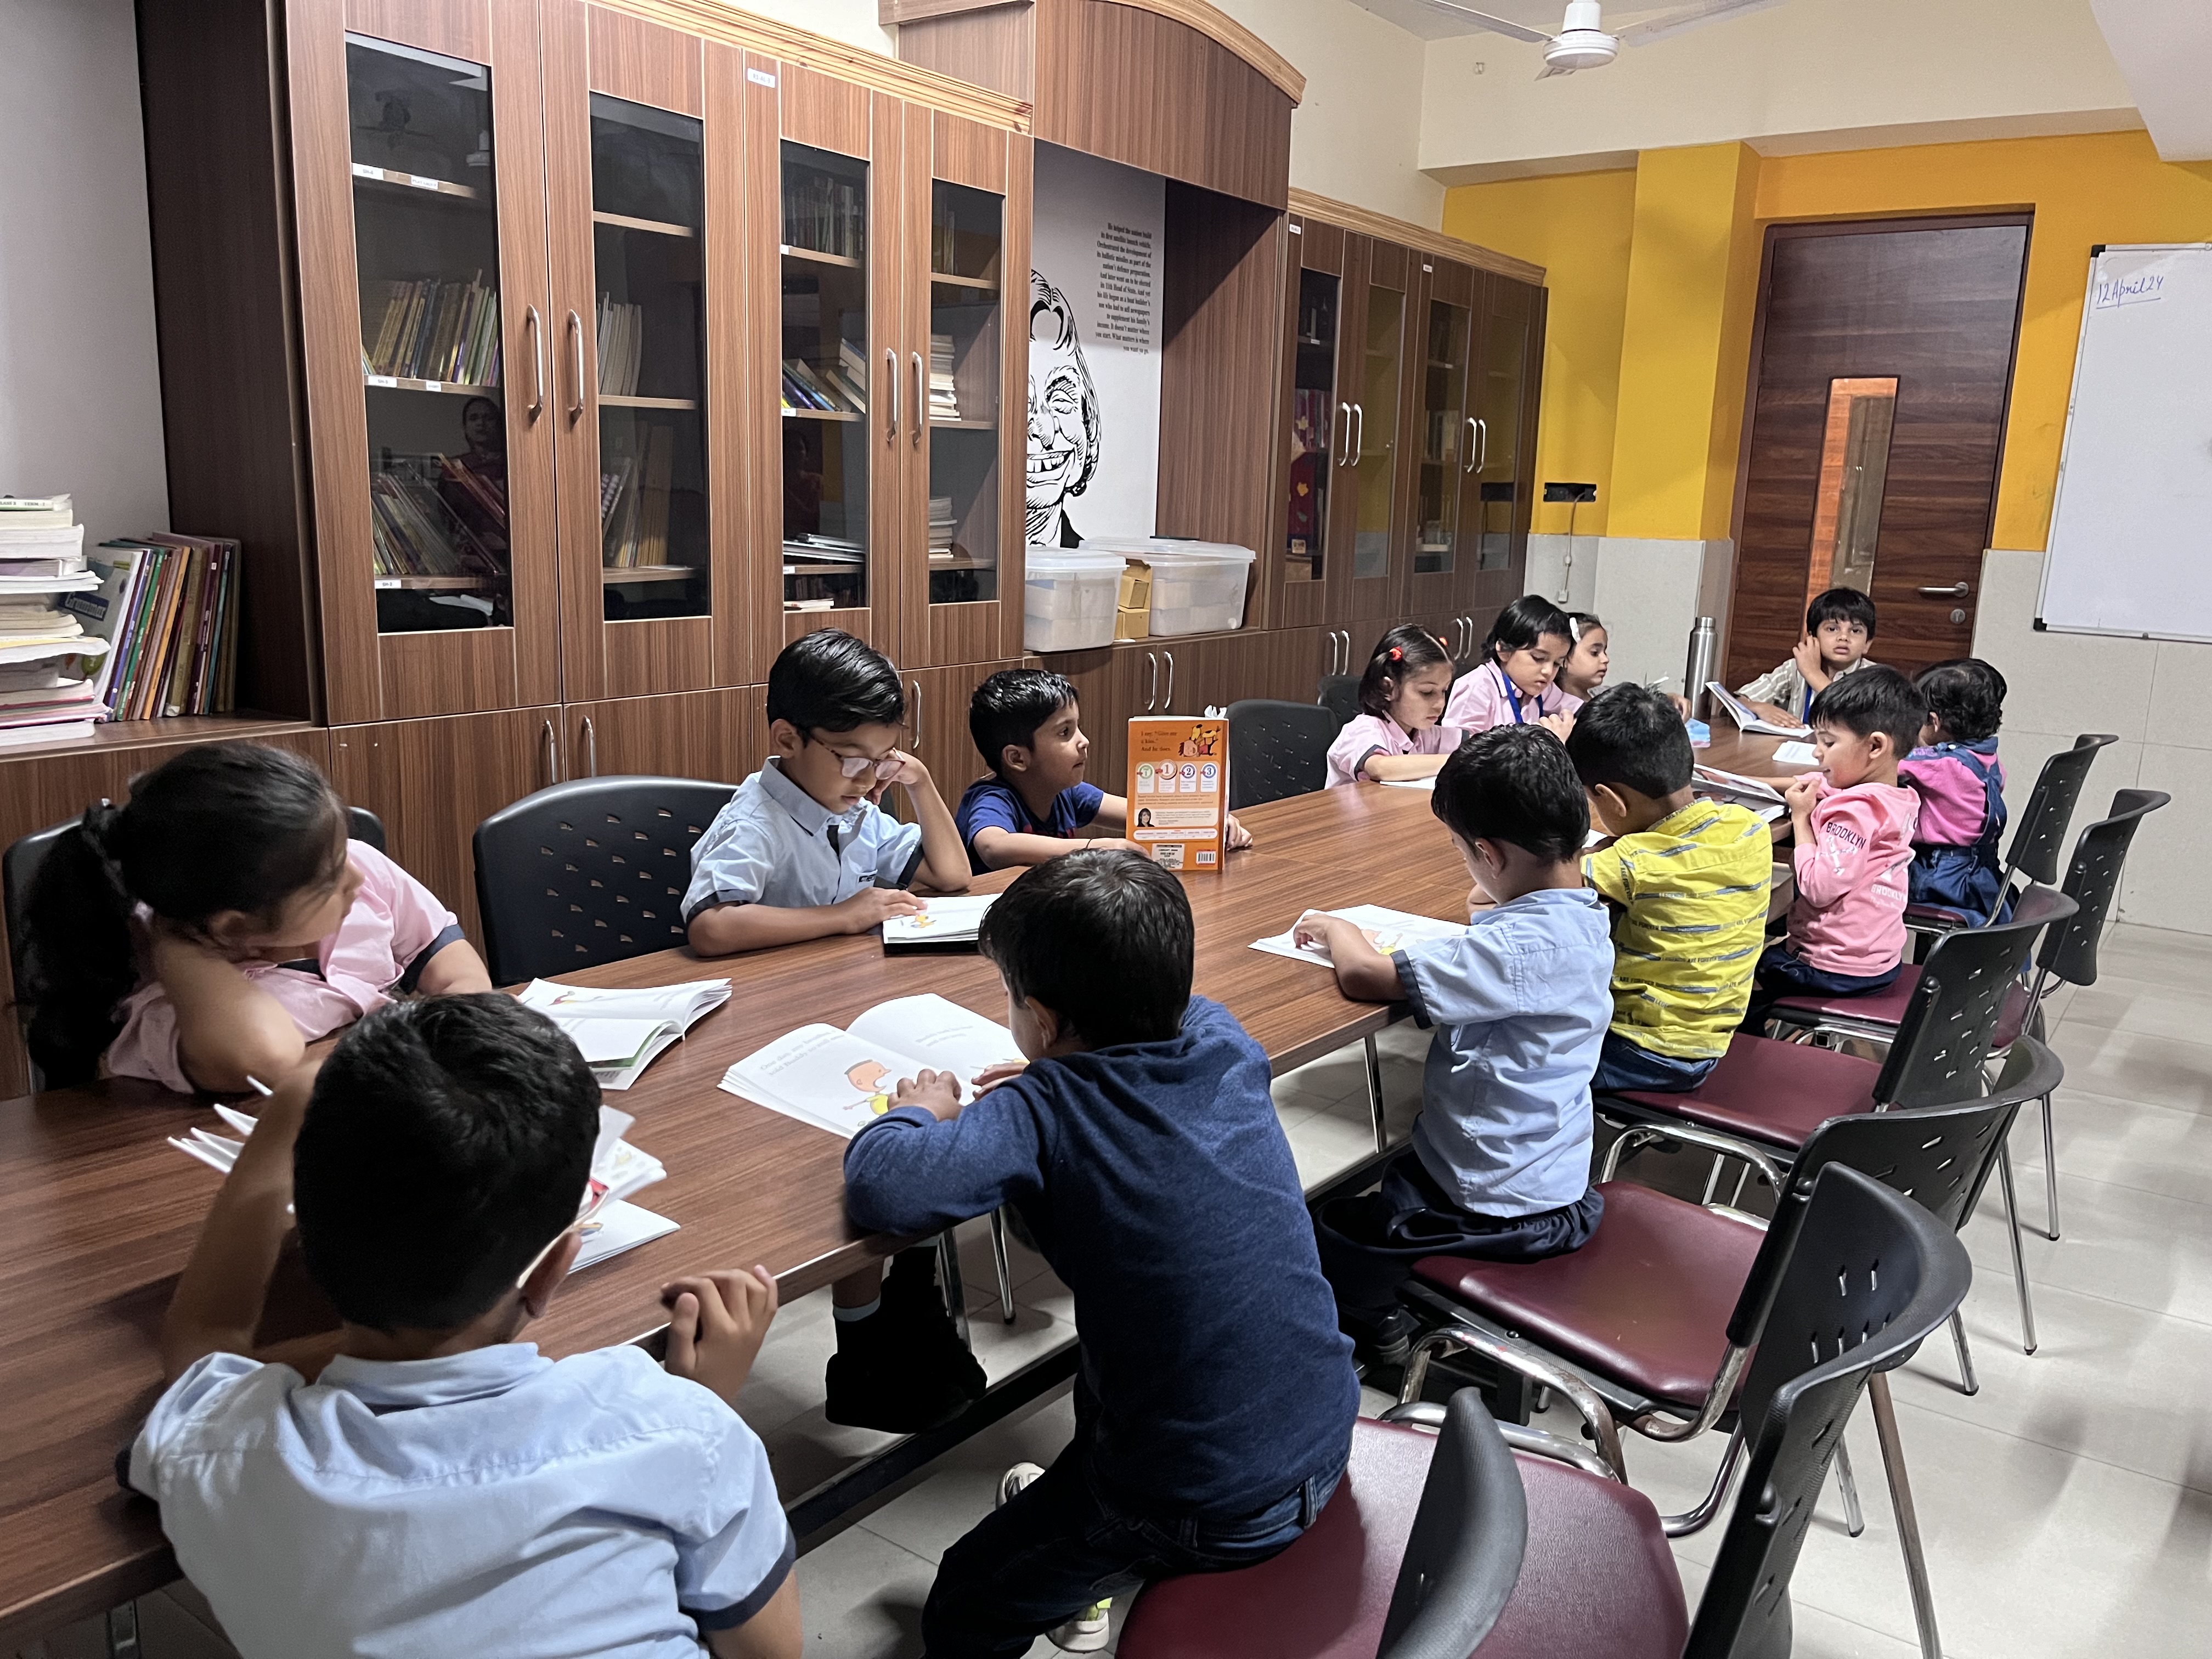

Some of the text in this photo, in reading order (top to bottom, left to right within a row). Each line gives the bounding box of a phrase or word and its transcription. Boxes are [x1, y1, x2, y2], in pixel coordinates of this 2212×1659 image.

[1126, 248, 1147, 257] development
[2097, 283, 2110, 304] 12
[2112, 277, 2146, 308] April
[1131, 309, 1150, 317] newspapers
[1111, 314, 1130, 323] supplement
[1826, 822, 1867, 850] BROOKLYN
